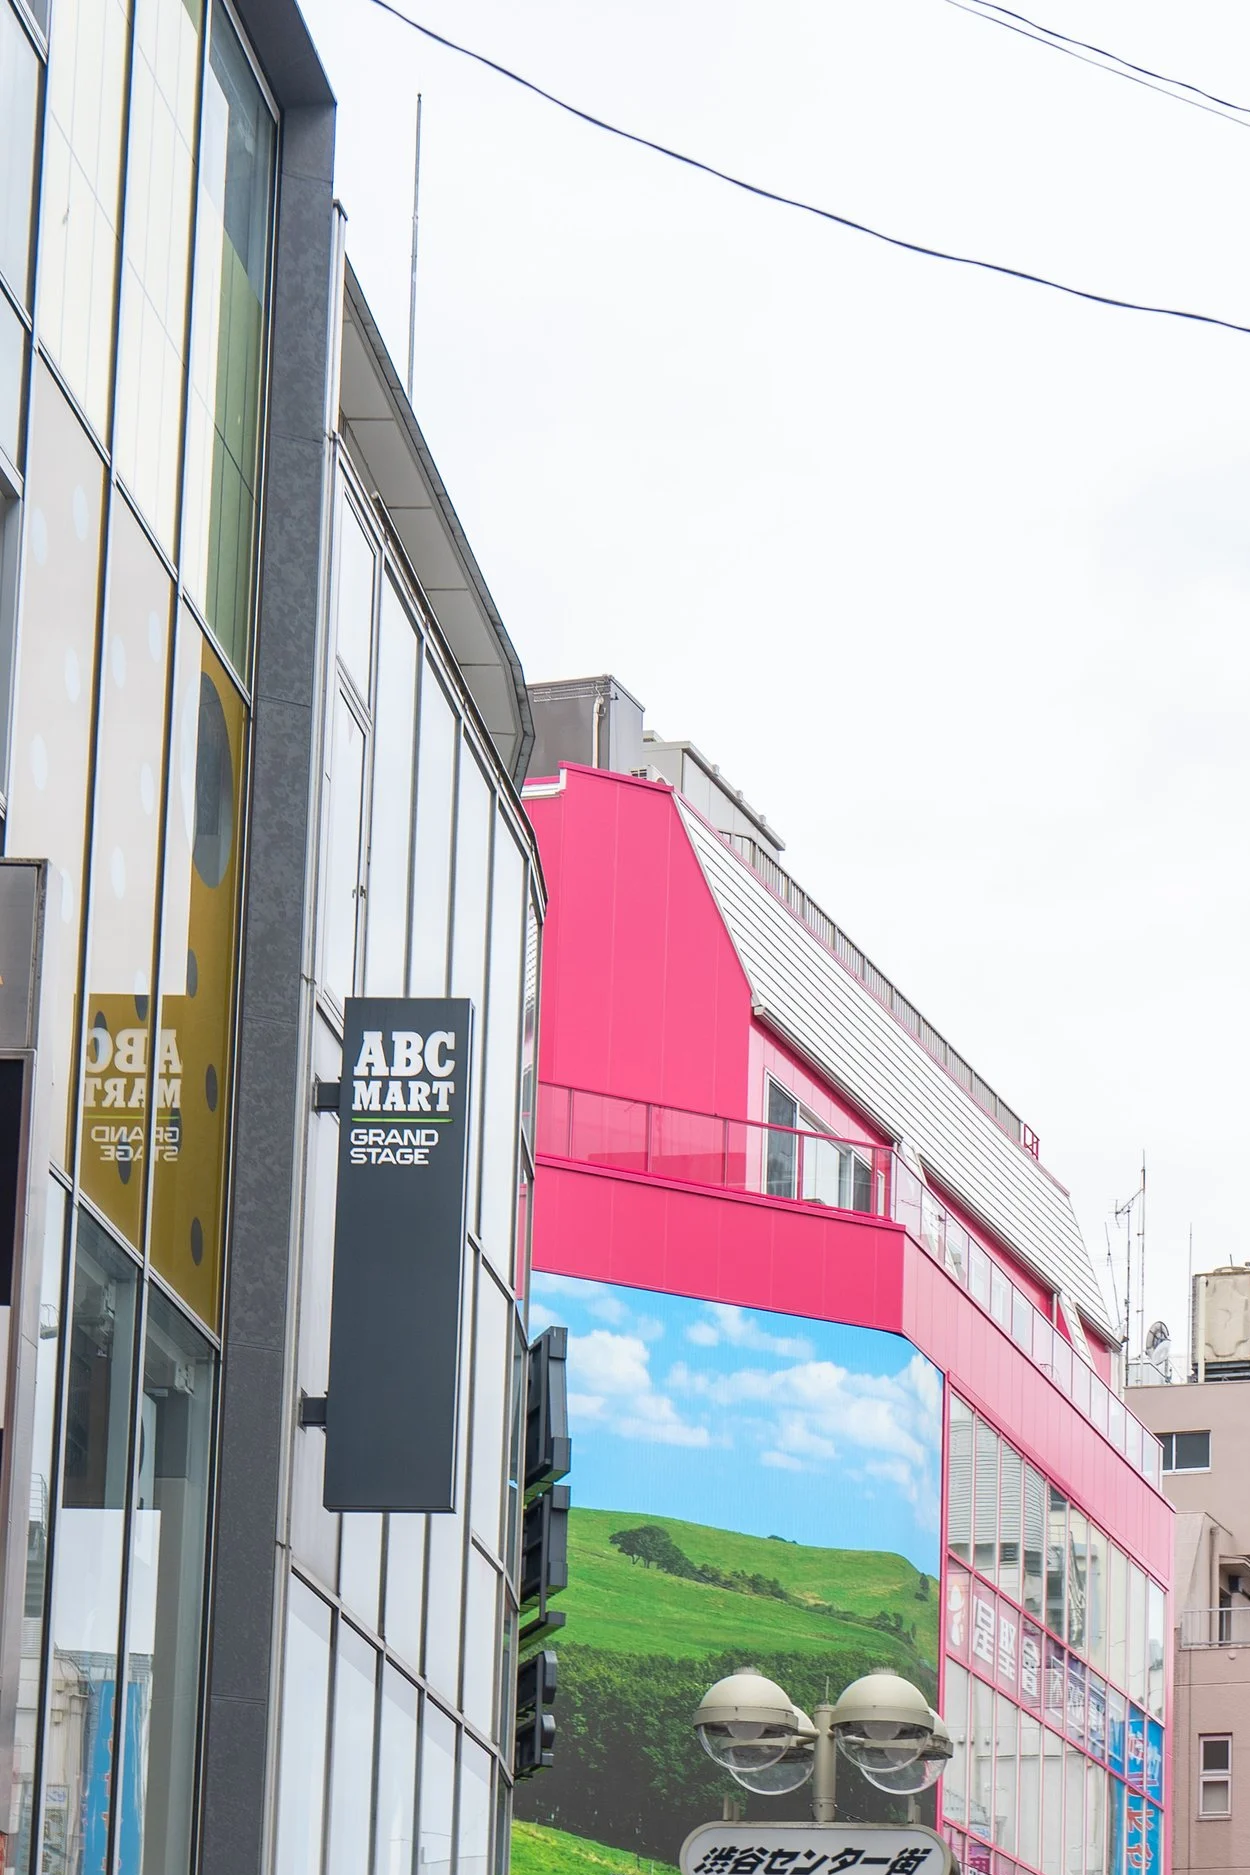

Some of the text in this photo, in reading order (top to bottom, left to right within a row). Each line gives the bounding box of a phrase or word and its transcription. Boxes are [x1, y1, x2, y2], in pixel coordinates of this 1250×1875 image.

[353, 1030, 456, 1079] ABC
[351, 1080, 455, 1113] MART
[350, 1128, 440, 1146] GRAND
[350, 1148, 430, 1166] STAGE
